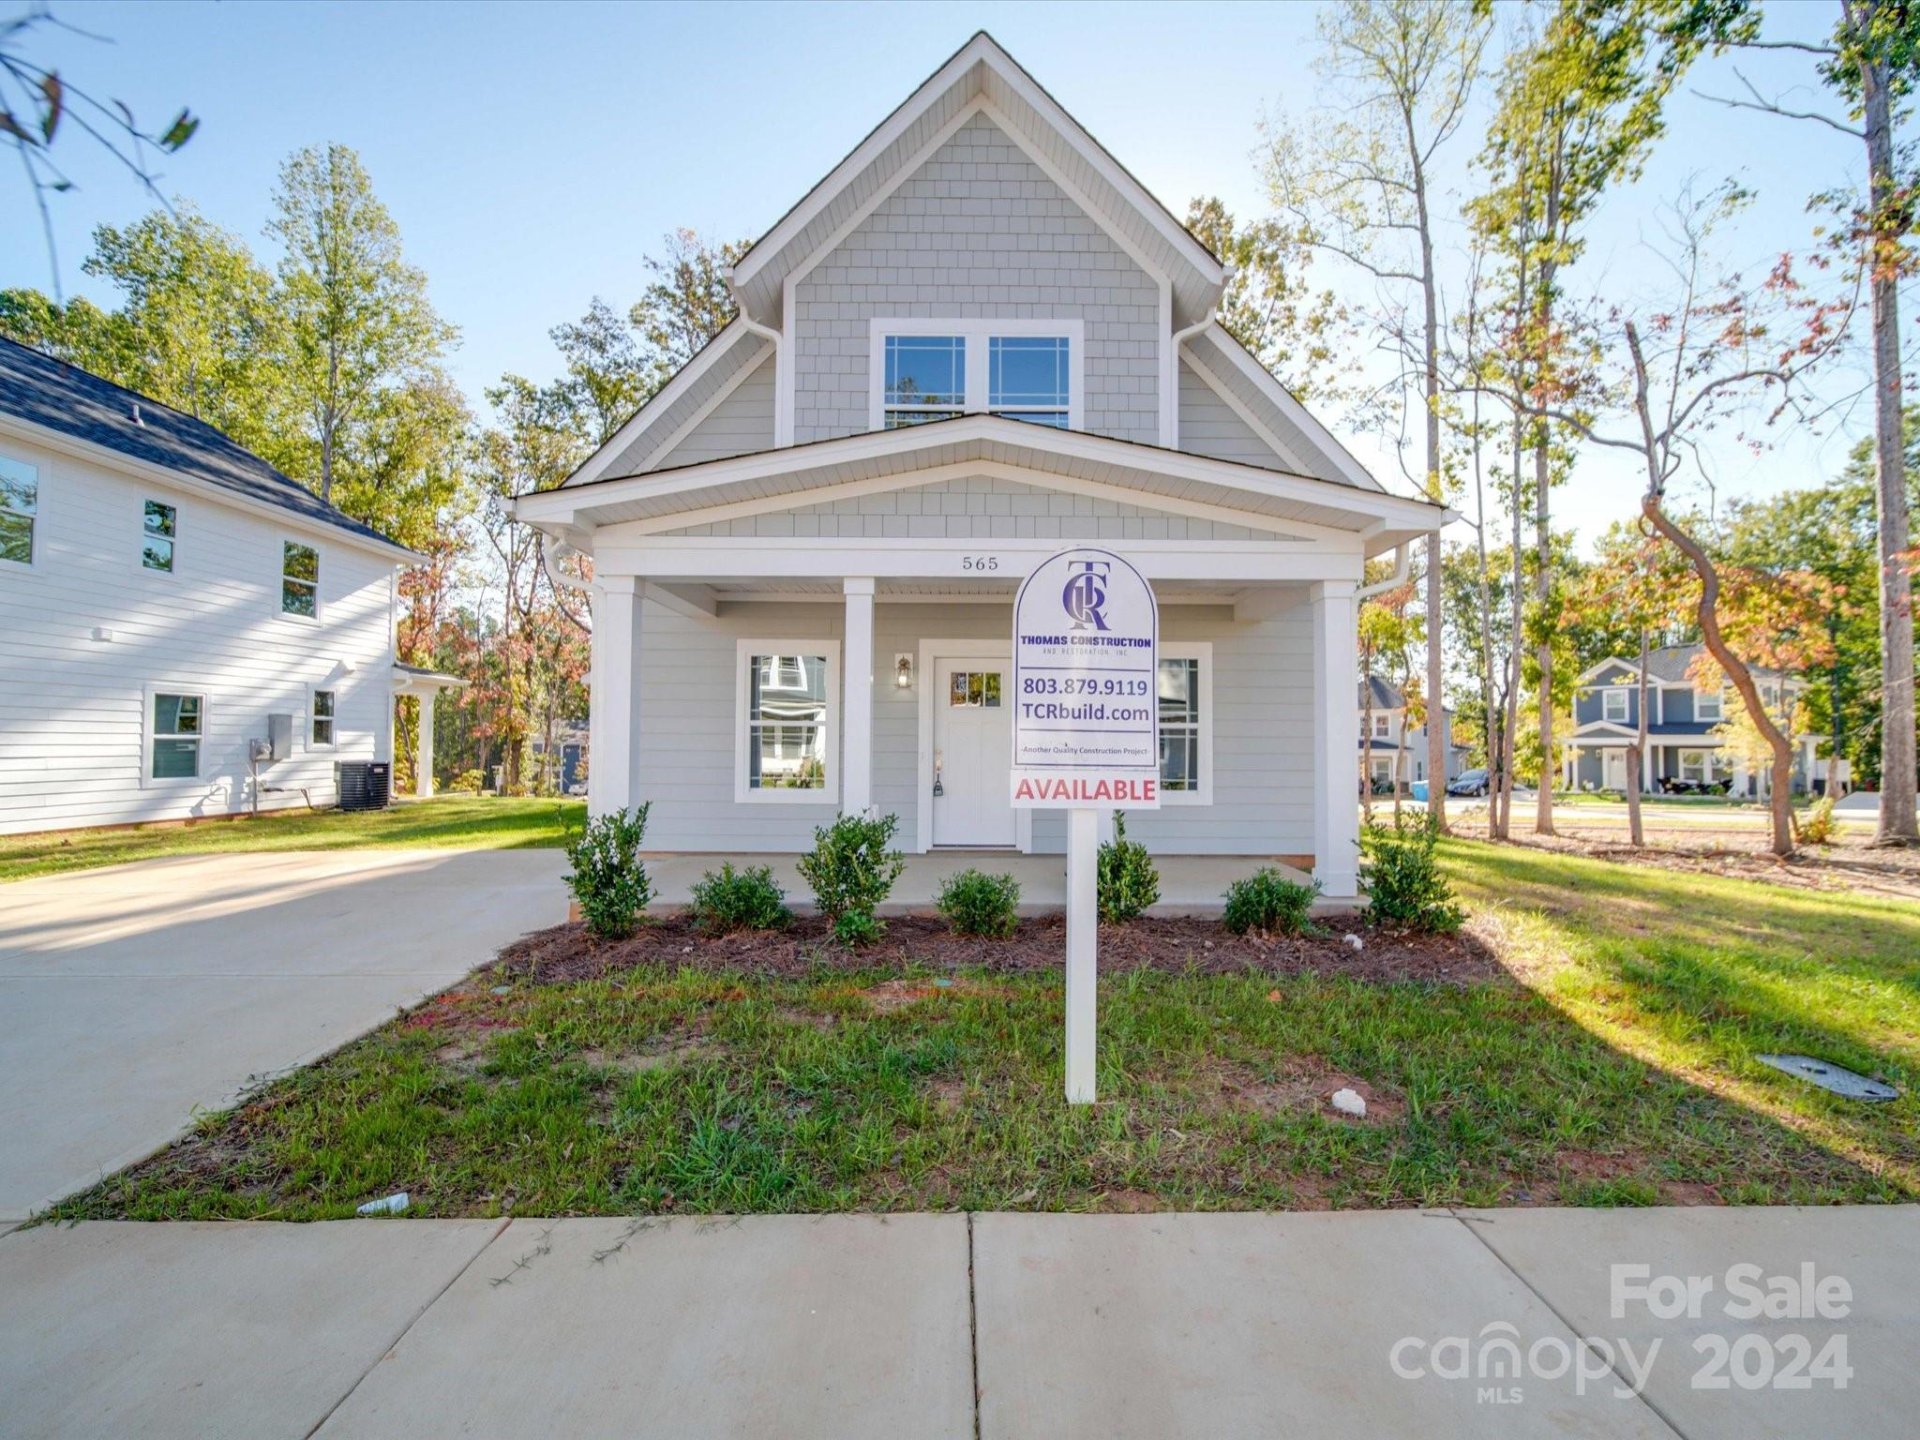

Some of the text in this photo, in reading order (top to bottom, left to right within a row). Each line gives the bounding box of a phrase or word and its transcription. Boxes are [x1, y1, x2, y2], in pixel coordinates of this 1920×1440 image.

[962, 556, 998, 571] 565
[1020, 635, 1151, 648] THOMAS CONSTRUCTION
[1023, 678, 1148, 696] 803.879.9119
[1022, 703, 1149, 721] TCRbuild.com
[1053, 746, 1078, 755] Quality
[1079, 746, 1122, 755] Construction
[1015, 778, 1156, 801] AVAILABLE
